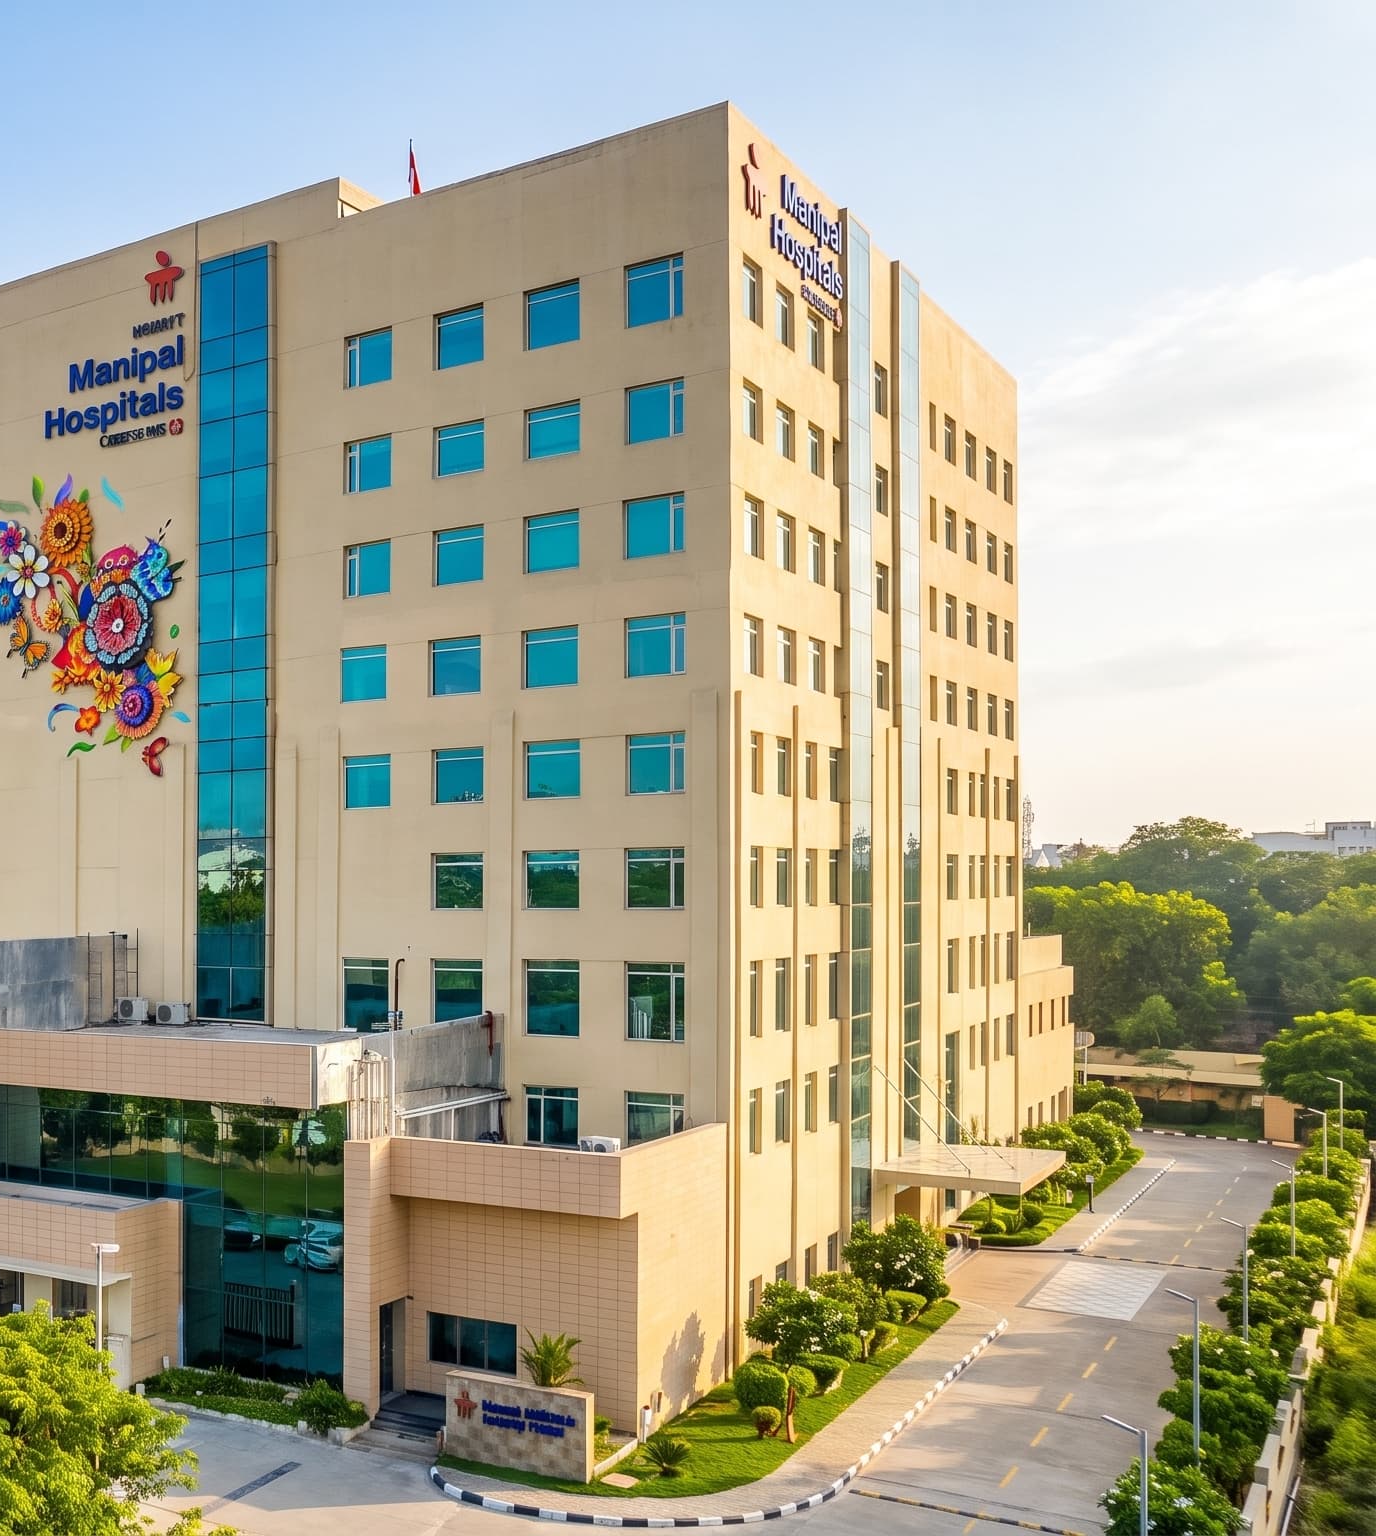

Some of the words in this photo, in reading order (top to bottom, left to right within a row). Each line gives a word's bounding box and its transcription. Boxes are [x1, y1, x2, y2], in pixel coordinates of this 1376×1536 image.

[780, 174, 842, 255] Manipal
[770, 212, 843, 300] Hospitals
[69, 334, 184, 393] Manipal
[45, 382, 184, 440] Hospitals
